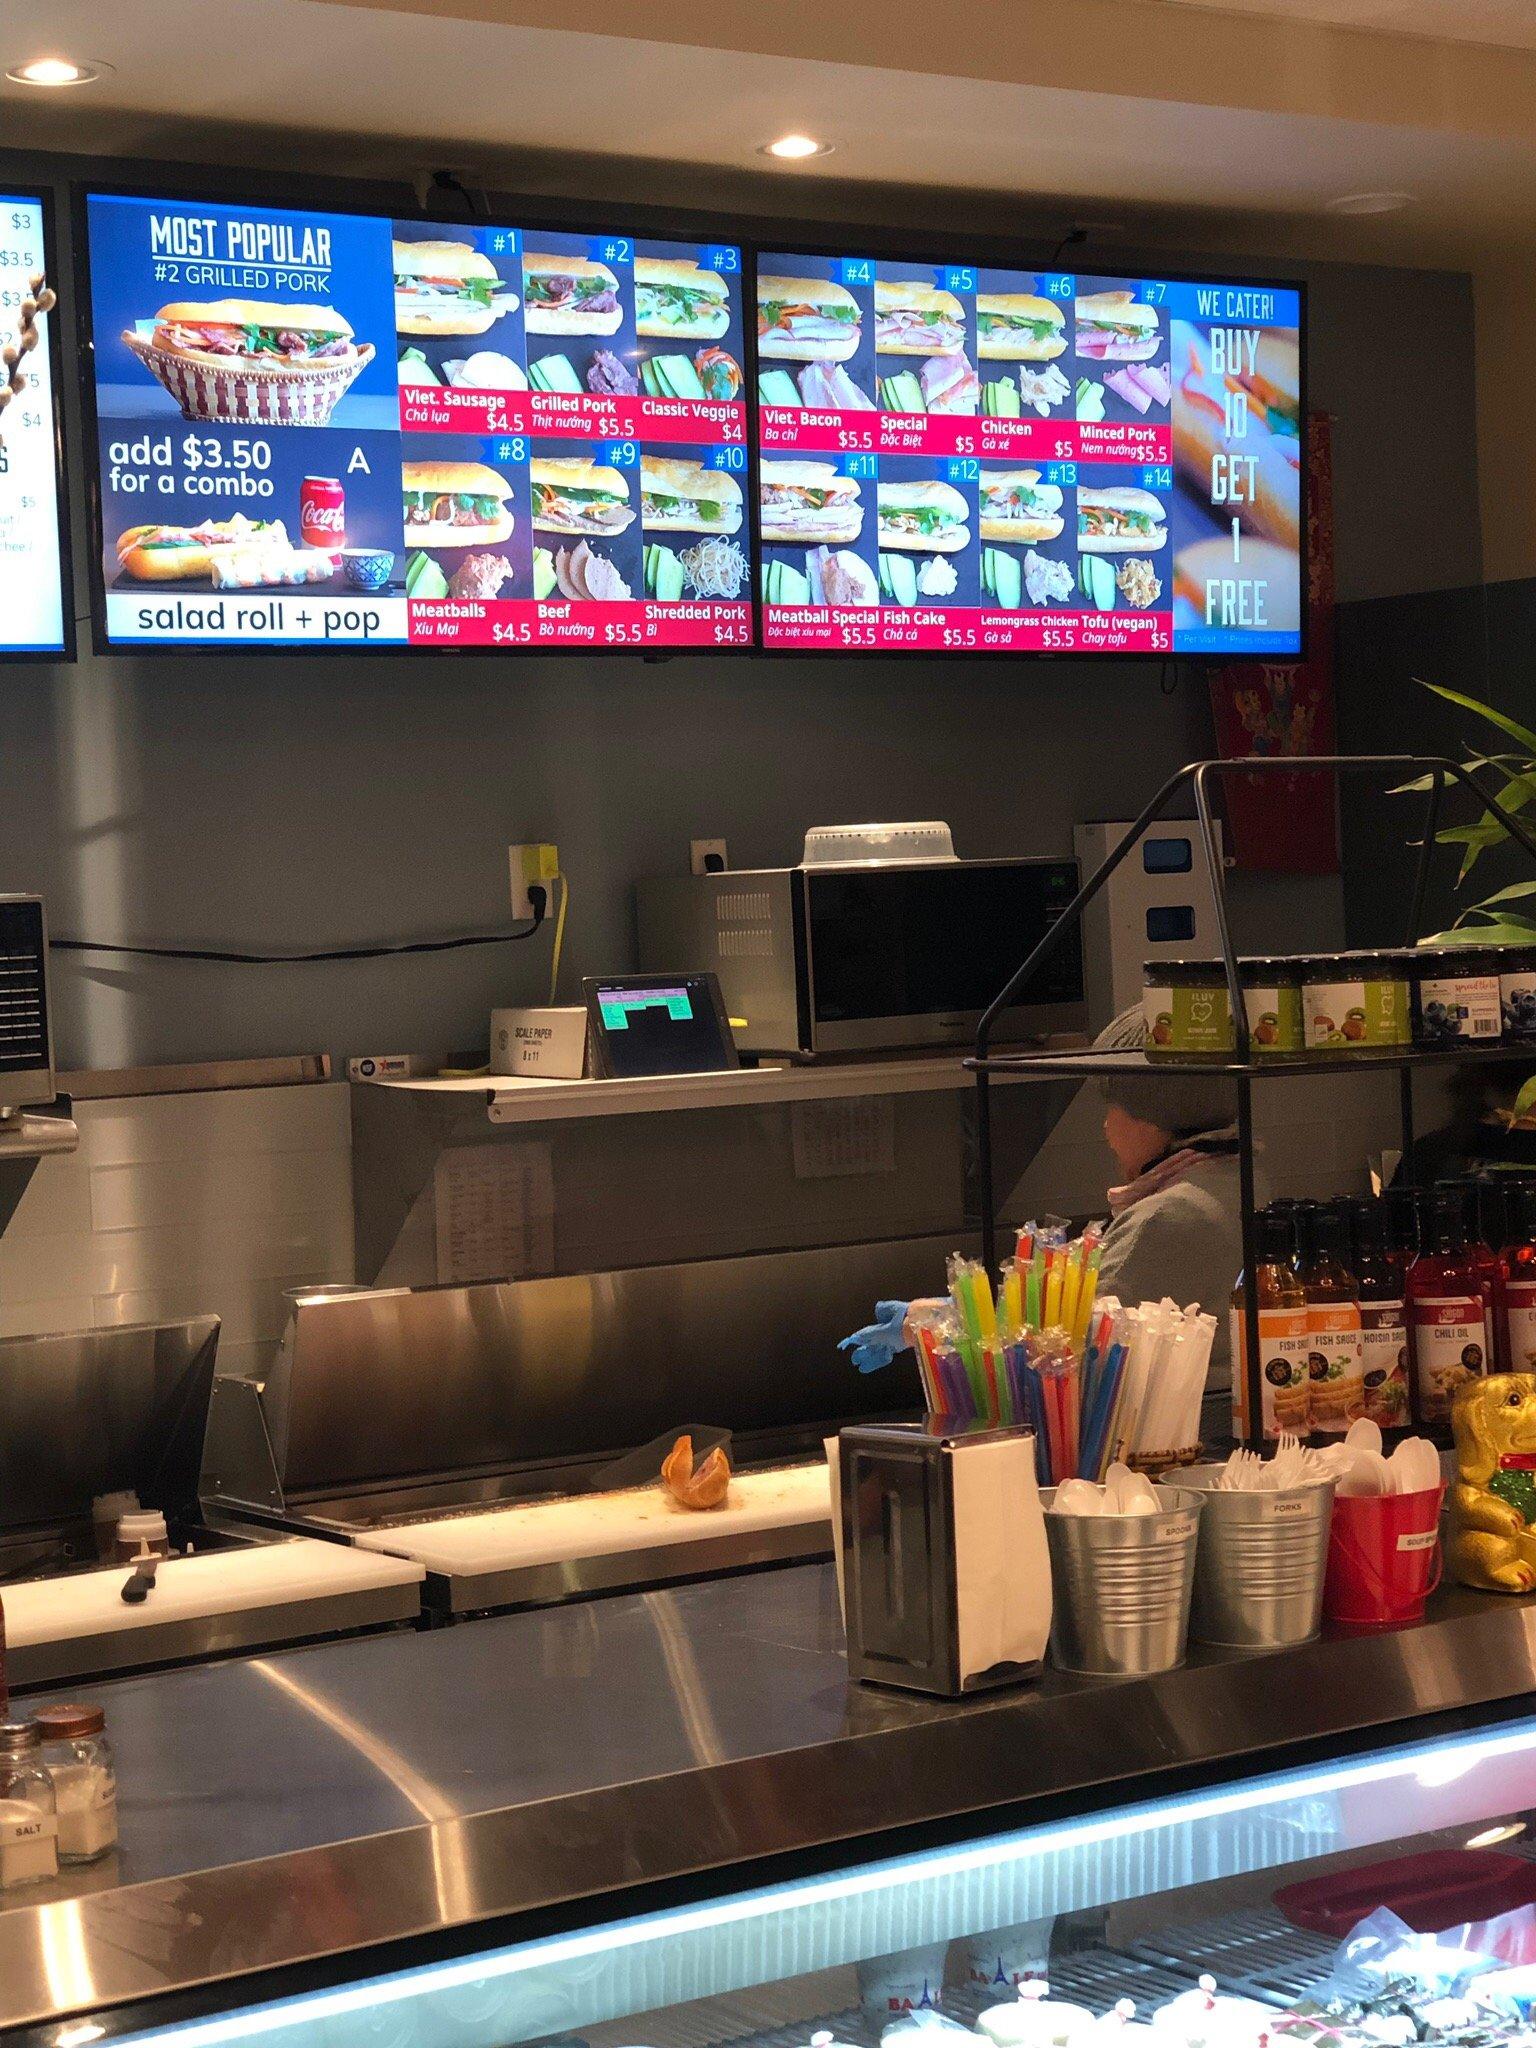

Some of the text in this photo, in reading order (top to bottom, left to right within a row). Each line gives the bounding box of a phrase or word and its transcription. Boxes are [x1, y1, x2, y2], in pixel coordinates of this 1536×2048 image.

[11, 212, 31, 229] $3
[150, 214, 331, 266] MOST POPULAR
[494, 231, 517, 253] #1
[0, 250, 33, 267] $3.5
[604, 239, 630, 263] #2
[713, 248, 737, 270] #3
[154, 264, 331, 293] #2 GRILLED PORK
[846, 262, 870, 283] #4
[949, 268, 973, 289] #5
[1049, 275, 1072, 297] #6
[1145, 283, 1168, 303] #7
[1197, 289, 1274, 320] WE CATER!
[1210, 327, 1261, 376] BUY
[404, 388, 506, 411] Viet. Sausage
[531, 395, 617, 413] Grilled Pork
[22, 411, 41, 428] $4
[641, 400, 739, 422] Classic Veggie
[764, 409, 842, 427] Viet. Bacon
[1224, 391, 1247, 438] 10
[486, 411, 524, 432] $4.5
[598, 416, 635, 437] $5.5
[722, 422, 743, 441] $4
[880, 415, 928, 433] Special
[981, 419, 1032, 436] Chicken
[764, 427, 779, 441] Ba
[838, 429, 873, 449] $5.5
[1079, 424, 1157, 442] Minced Pork
[109, 434, 272, 471] add $3.50
[499, 437, 525, 461] #8
[610, 442, 636, 465] #9
[955, 435, 975, 454] $5
[1054, 439, 1073, 458] $5
[1081, 441, 1103, 454] Nem
[1136, 444, 1168, 463] $5.5
[347, 446, 371, 475] A
[714, 446, 744, 469] #10
[847, 454, 876, 476] #11
[948, 457, 979, 481] #12
[1048, 463, 1077, 484] #13
[1143, 466, 1171, 488] #14
[1211, 453, 1260, 503] GET
[109, 468, 274, 498] for a combo
[1230, 517, 1241, 563] 1
[411, 602, 487, 618] Meatballs
[537, 603, 571, 619] Beef
[645, 604, 747, 620] Shredded Pork
[1205, 578, 1268, 626] FREE
[138, 601, 226, 631] salad
[236, 603, 284, 631] roll
[324, 609, 381, 639] pop
[768, 608, 880, 627] Meatball Special
[883, 610, 946, 625] Fish Cake
[980, 614, 1079, 628] Lemongrass Chicken
[1081, 614, 1158, 632] Tofu (vegan)
[492, 622, 531, 643] $4.5
[604, 623, 642, 643] $5.5
[714, 623, 749, 644] $4.5
[841, 626, 876, 645] $5.5
[943, 627, 976, 647] $5.5
[1042, 629, 1075, 647] $5.5
[1081, 631, 1128, 648] Chay tofu
[1150, 631, 1169, 649] $5
[514, 1027, 553, 1039] SCALE PAPER
[1315, 1333, 1358, 1347] FISH SAUCE
[1434, 1328, 1470, 1339] CHILI OIL
[1279, 1340, 1296, 1351] FISH
[1274, 1503, 1302, 1513] FORKS
[15, 1823, 42, 1837] SALT
